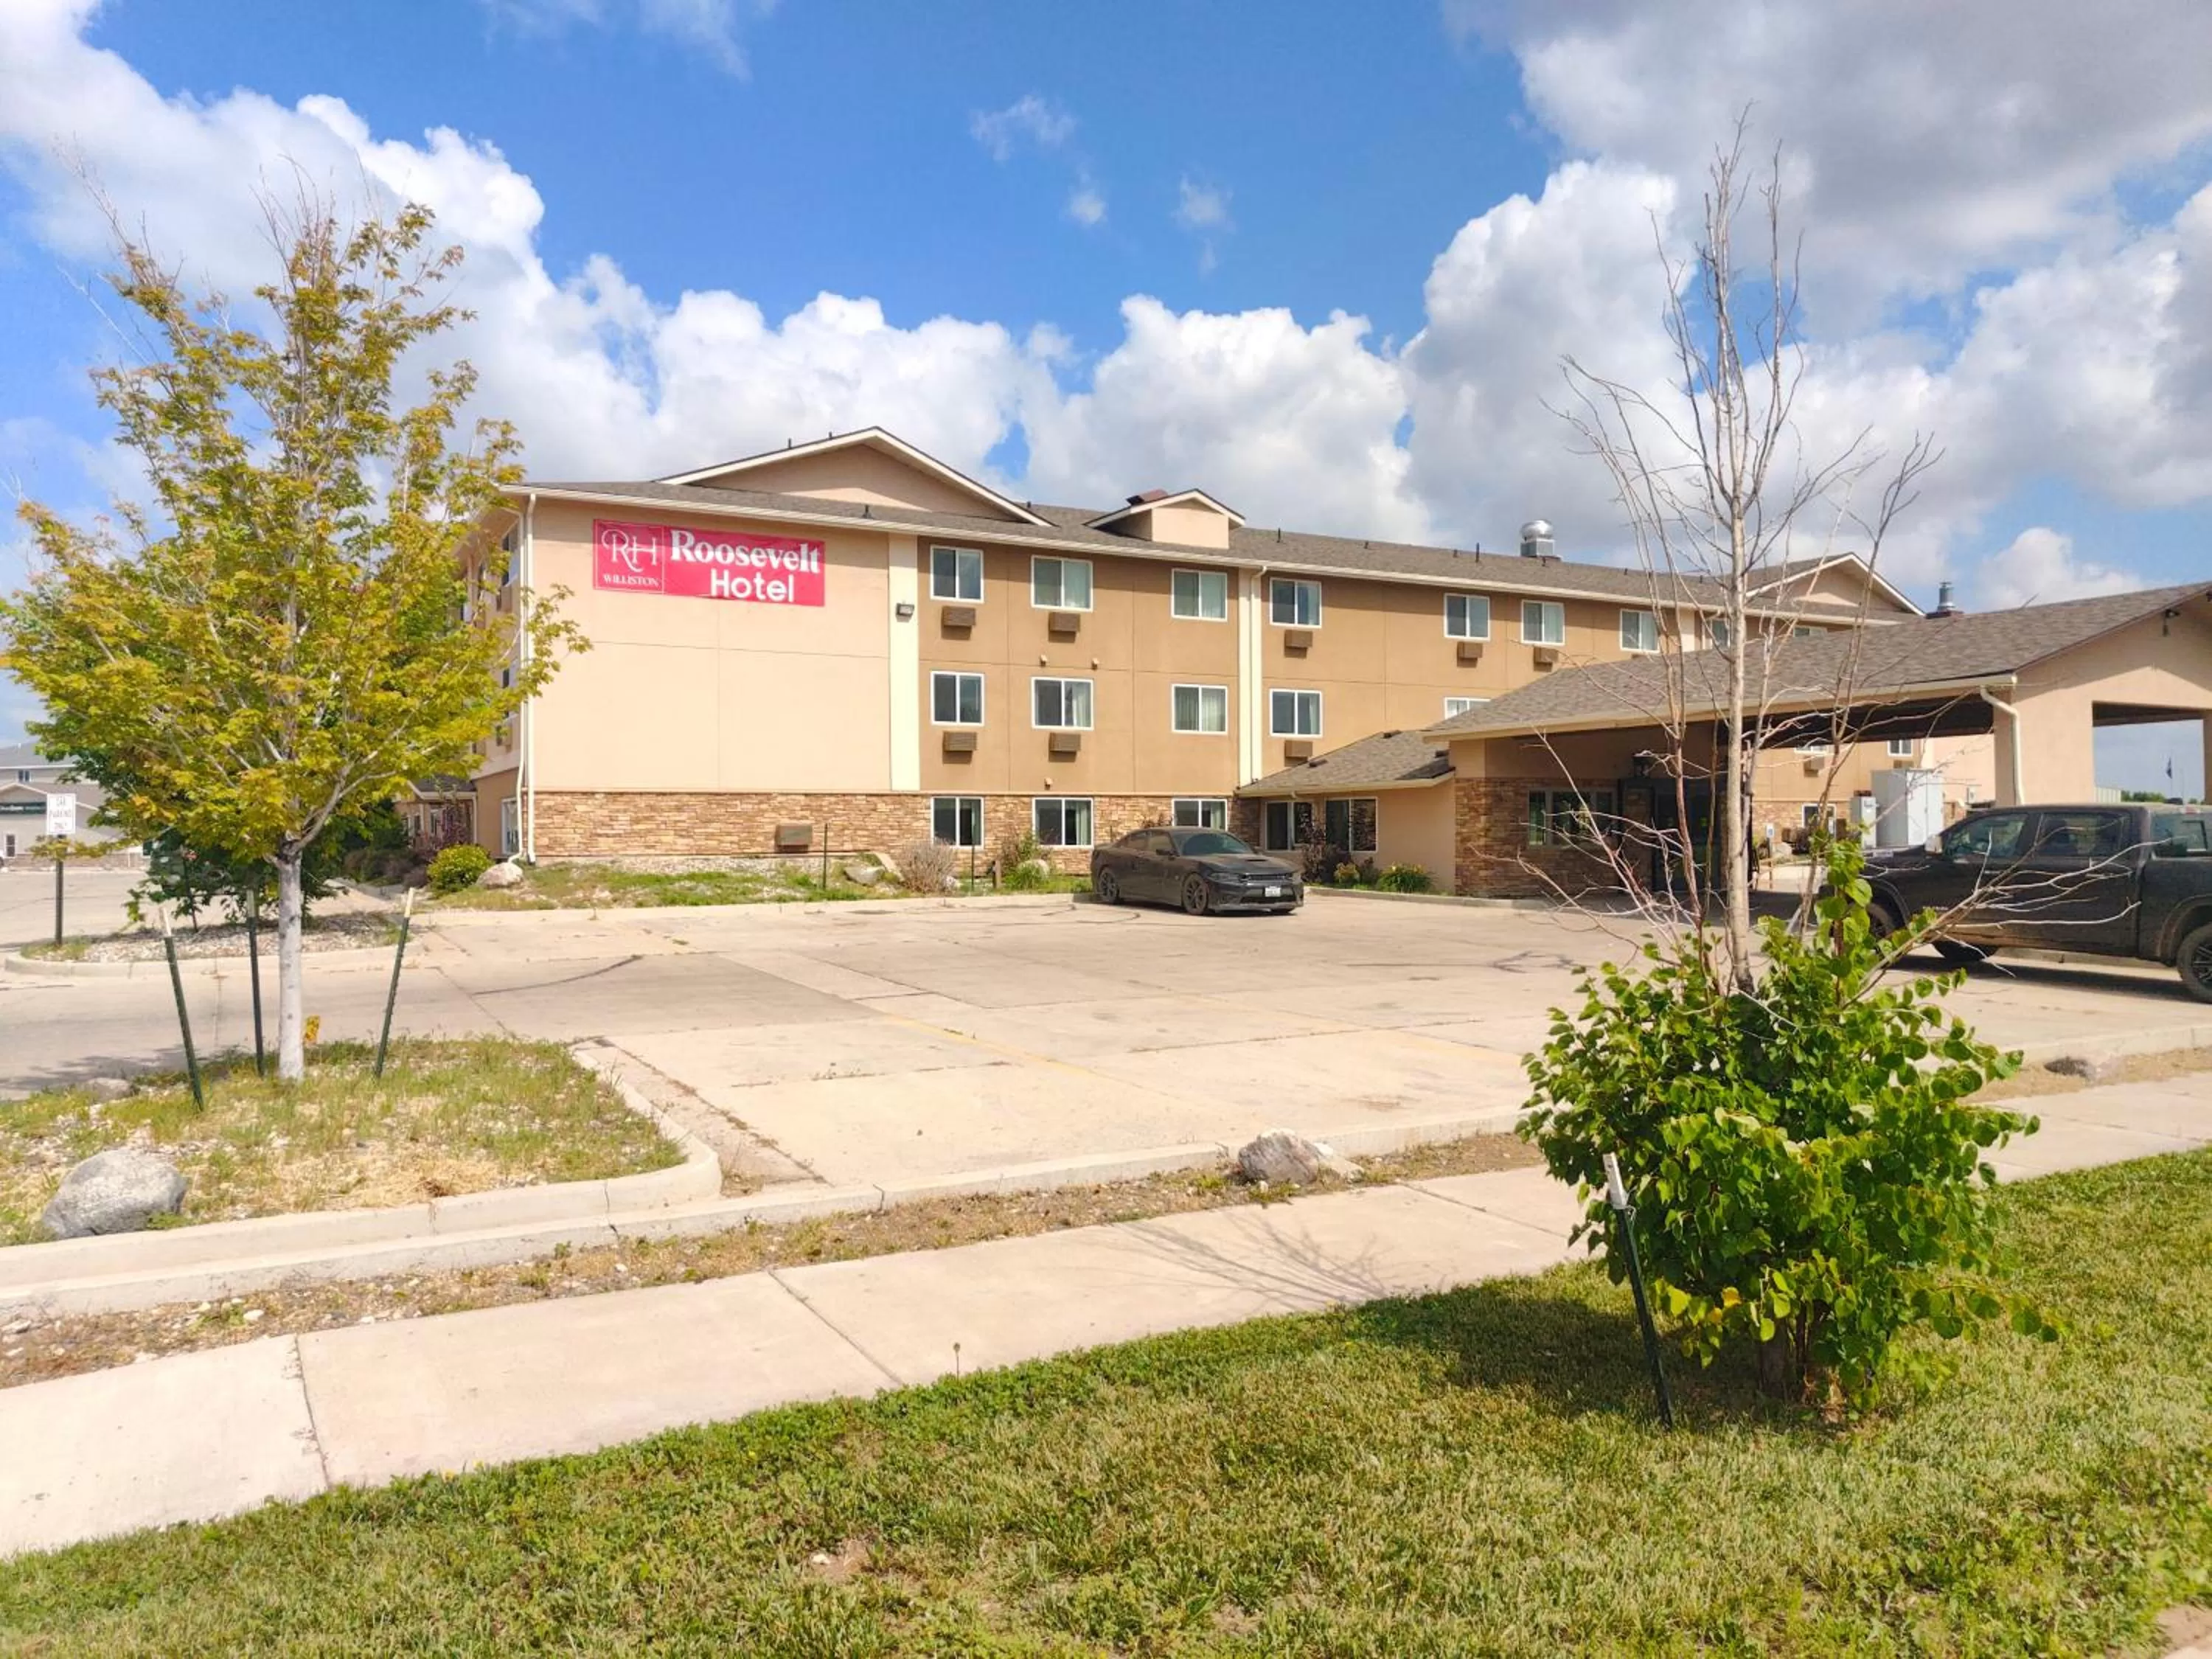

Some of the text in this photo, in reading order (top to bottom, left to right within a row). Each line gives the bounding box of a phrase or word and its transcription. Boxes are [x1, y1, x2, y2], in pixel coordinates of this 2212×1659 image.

[670, 529, 820, 573] Roosevelt
[603, 574, 659, 587] WILLISTON
[710, 568, 794, 602] Hotel
